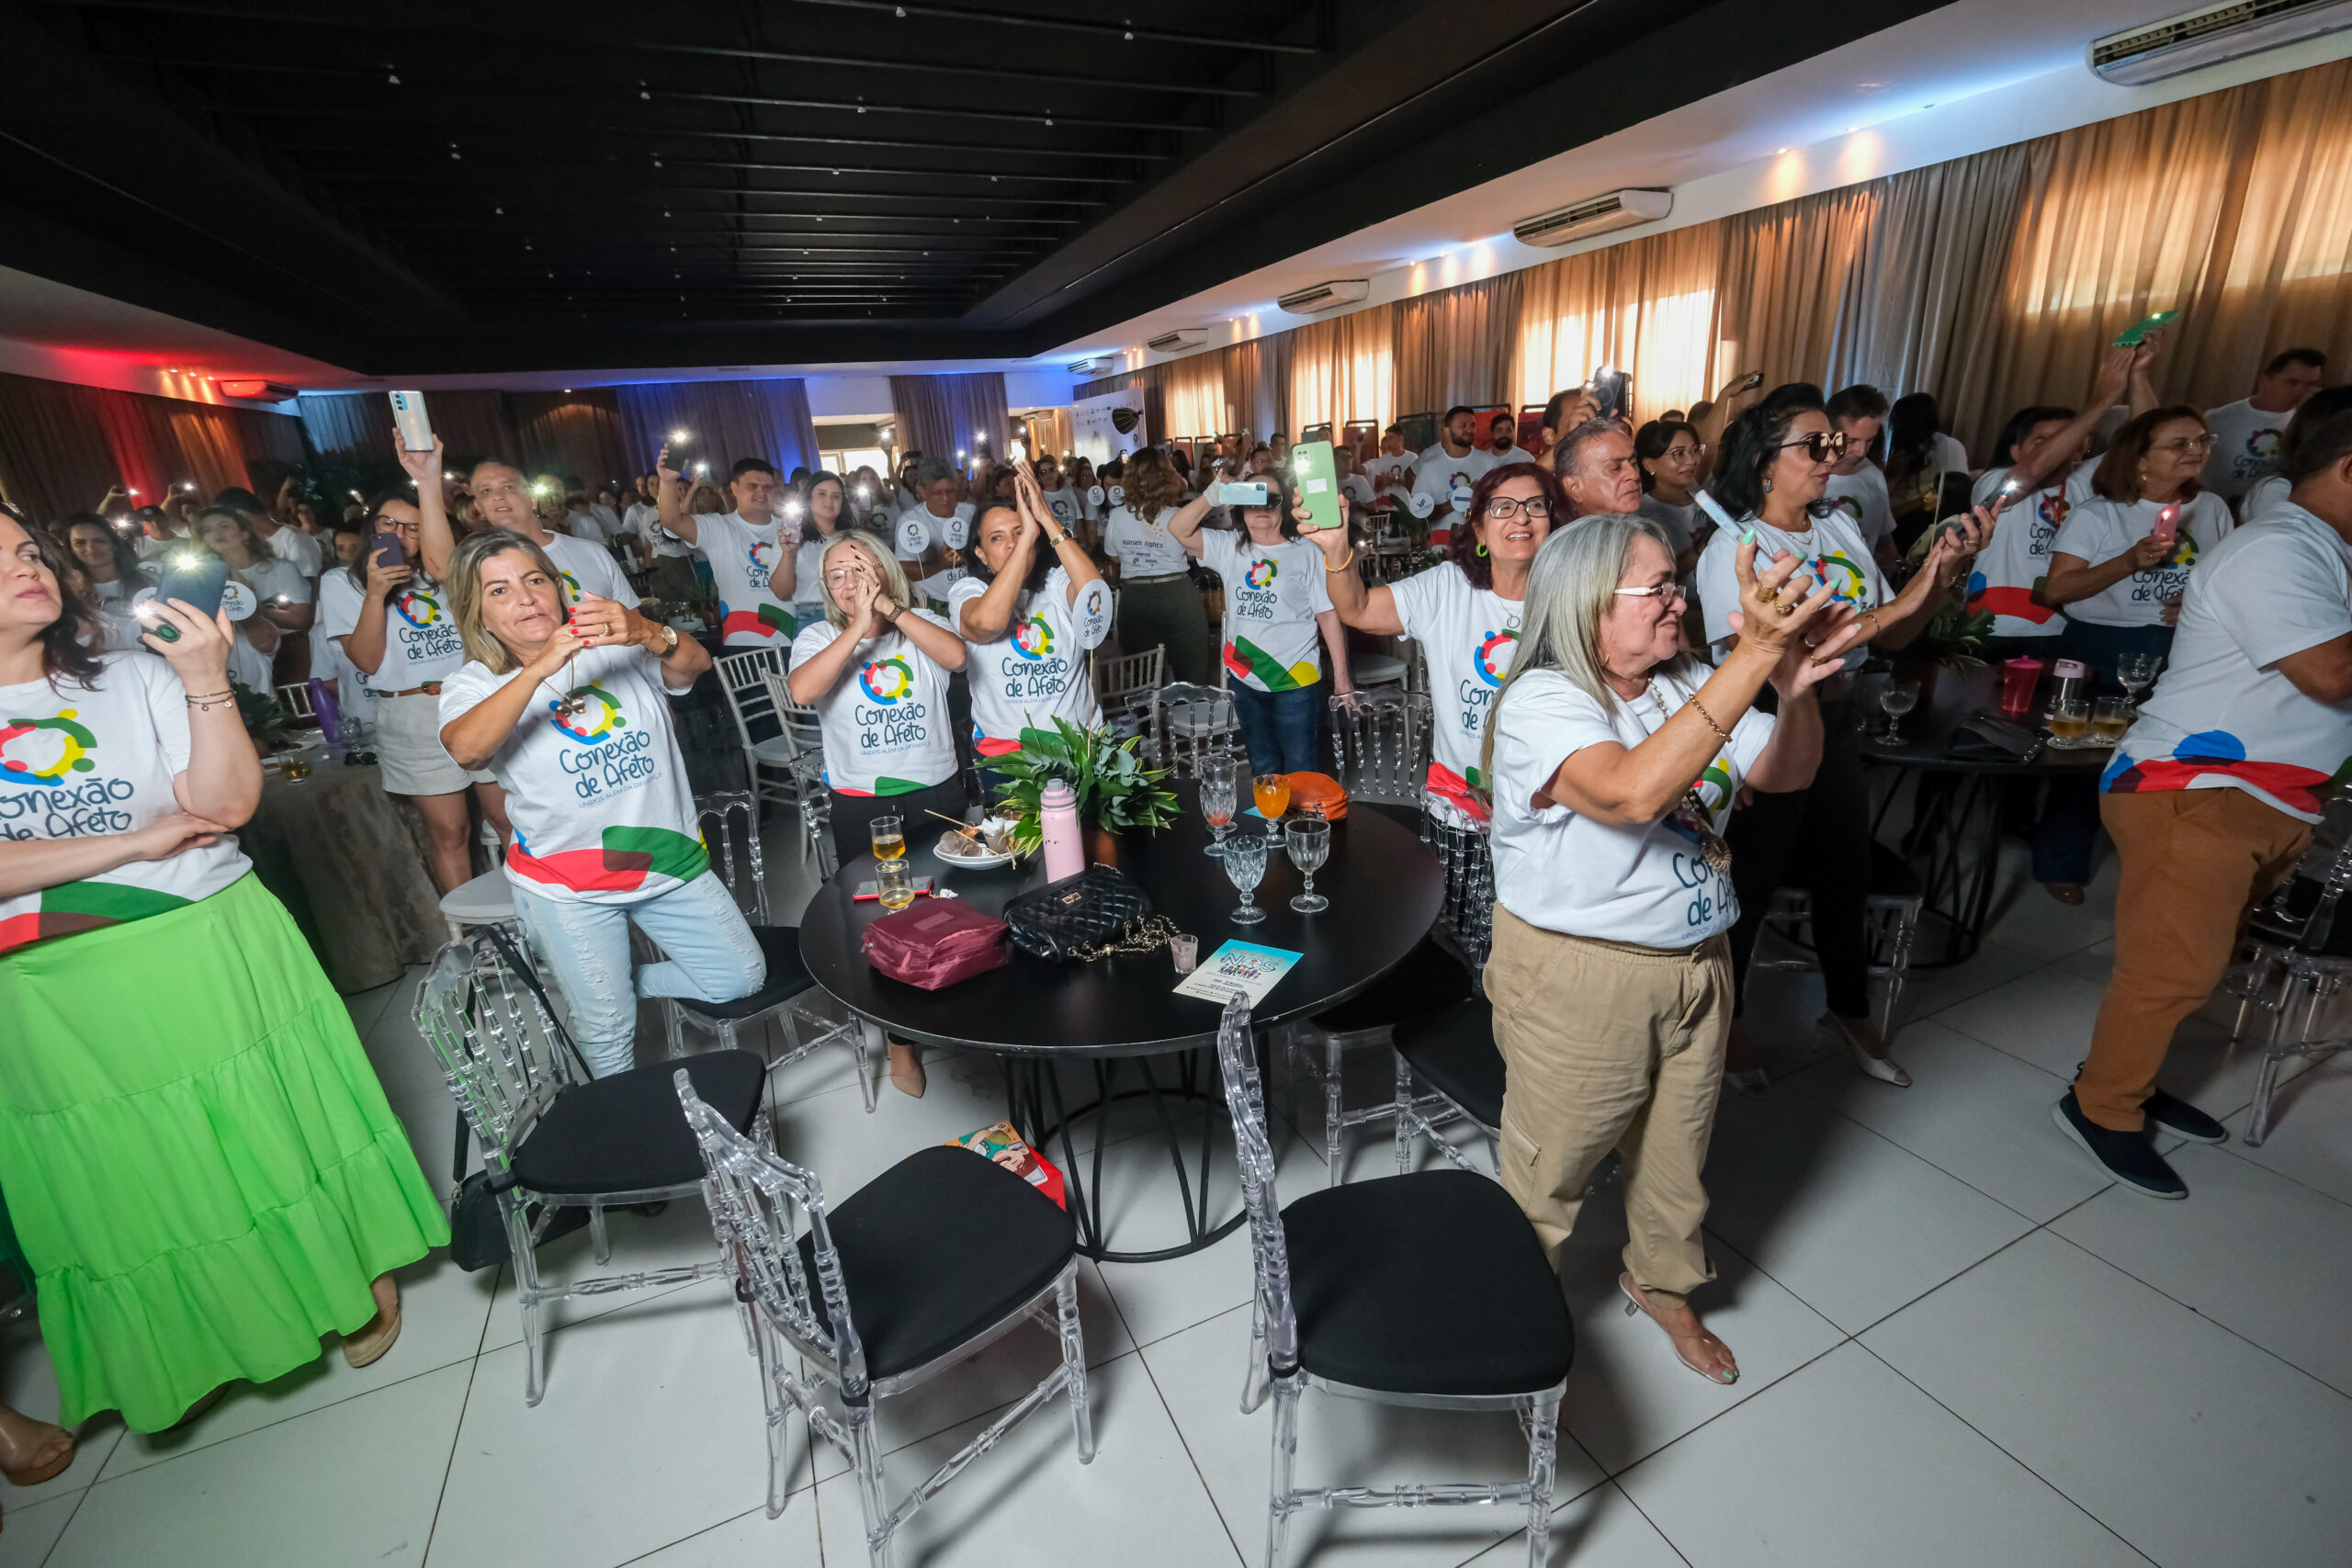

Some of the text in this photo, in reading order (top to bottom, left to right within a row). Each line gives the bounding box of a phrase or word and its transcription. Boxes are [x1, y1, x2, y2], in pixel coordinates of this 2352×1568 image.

[1144, 540, 1163, 548] lights
[2030, 539, 2045, 555] de
[750, 578, 761, 588] de
[2132, 570, 2190, 585] Conexã
[1236, 586, 1278, 604] Conexão
[2132, 584, 2151, 602] de
[1237, 601, 1273, 619] de Afeto
[399, 624, 459, 644] Conexão
[407, 643, 424, 660] de
[425, 638, 463, 658] Afeto
[1001, 657, 1069, 677] Conexão
[1005, 675, 1066, 698] de Afeto
[854, 702, 926, 726] Conexão
[1462, 705, 1478, 730] de
[860, 722, 926, 749] de Afeto
[559, 729, 650, 774] Conexão
[575, 753, 654, 799] de Afeto
[0, 777, 135, 820] onexão
[578, 795, 605, 808] UNIDOS
[45, 807, 132, 839] Afeto
[1687, 888, 1713, 927] de
